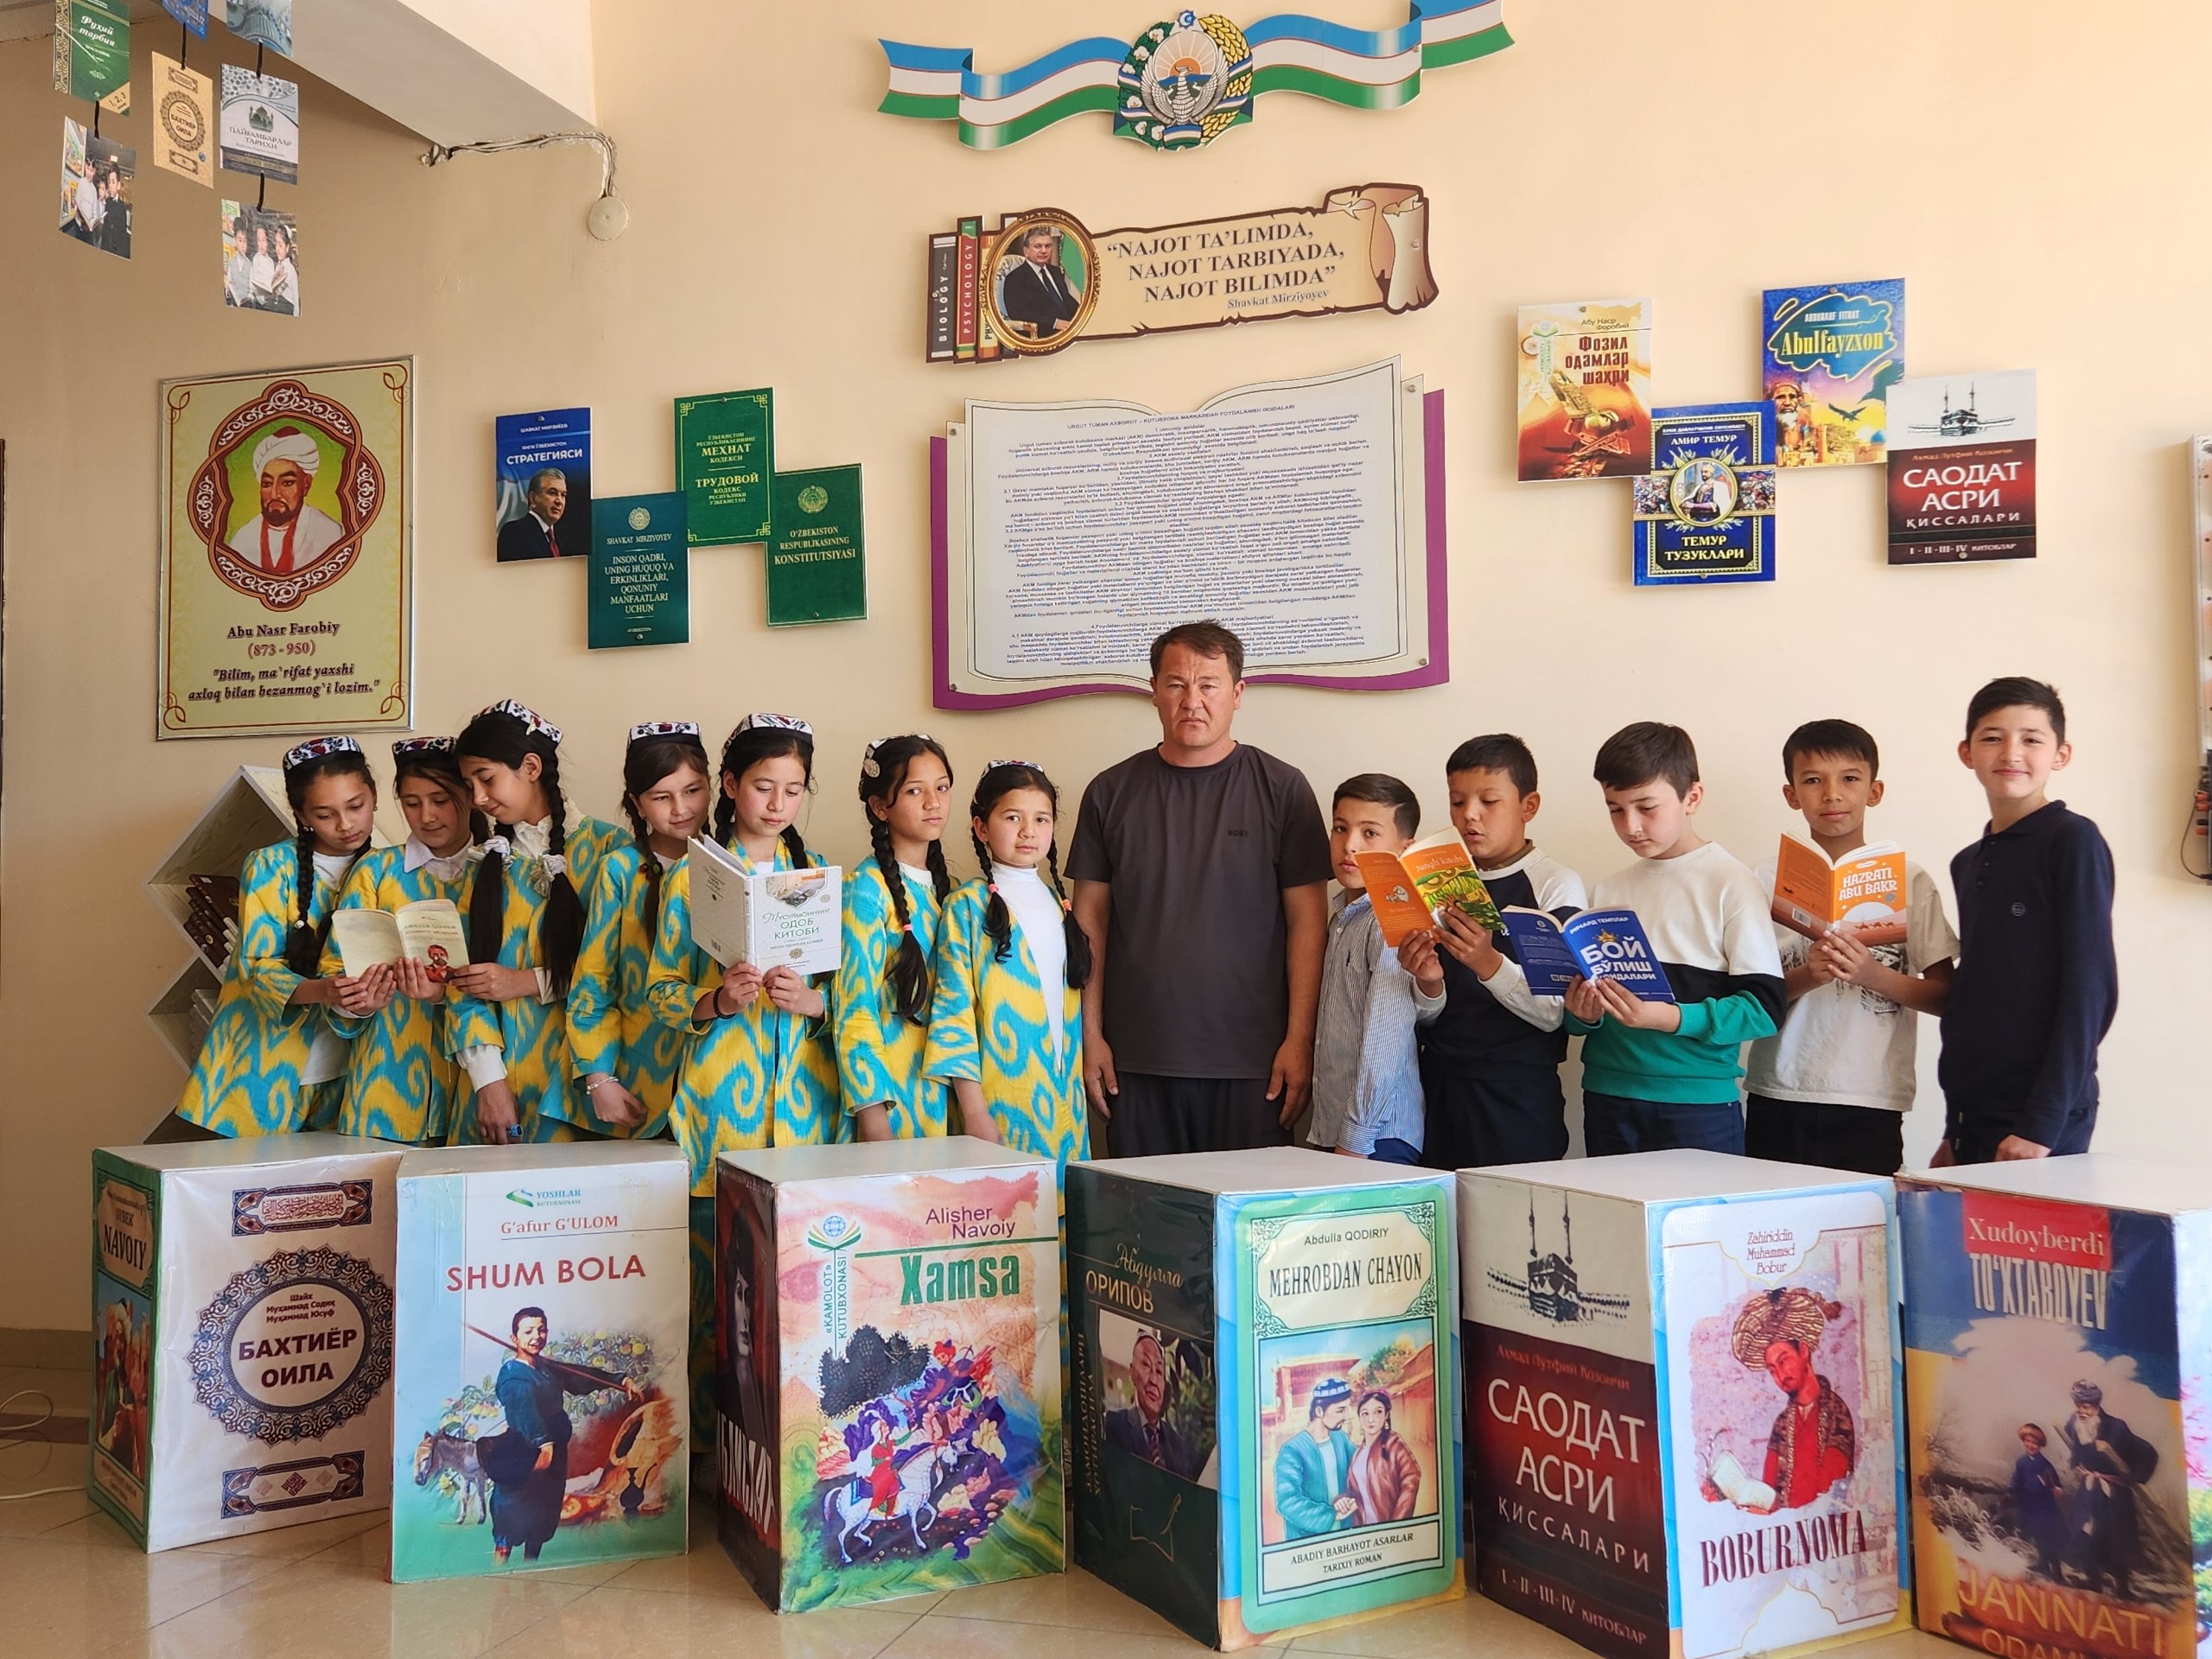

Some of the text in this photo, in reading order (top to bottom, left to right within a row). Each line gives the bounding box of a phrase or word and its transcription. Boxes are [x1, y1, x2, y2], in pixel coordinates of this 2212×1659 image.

[79, 28, 115, 47] тарбия
[1107, 222, 1313, 258] “NAJOT TA’LIMDA,
[1128, 242, 1344, 281] NAJOT TARBIYADA,
[963, 245, 973, 334] PSYCHOLOGY
[1143, 265, 1335, 302] NAJOT BILIMDA”
[939, 276, 948, 341] BIOLOGY
[1228, 290, 1329, 309] Shavkat Mirziyoyev
[1580, 336, 1628, 351] Фозил
[1781, 329, 1883, 359] Abulfayzxon
[1566, 353, 1628, 370] одамлар
[1583, 370, 1629, 386] шаҳри
[1702, 435, 1737, 443] ТЕМУР
[506, 448, 582, 465] СТРАТЕГИЯСИ
[695, 472, 759, 487] ТРУДОВОЙ
[1903, 461, 2024, 487] САОДАТ
[1921, 488, 2000, 512] АСРИ
[1906, 512, 2020, 529] ҚИССАЛАРИ
[636, 534, 671, 543] MIRZIYOYEV
[790, 526, 838, 537] O‘ZBEKISTON
[780, 537, 849, 550] RESPUBLIKASINING
[1681, 536, 1726, 546] ТЕМУР
[613, 553, 666, 564] INSON QADRI,
[774, 549, 855, 564] KONSTITUTSIYASI
[1664, 549, 1744, 561] ТУЗУКЛАРИ
[605, 566, 631, 575] UNING
[632, 563, 661, 573] HUQUQ
[610, 574, 669, 584] ERKINLIKLARI,
[621, 584, 658, 594] QONUNIY
[610, 593, 668, 604] MANFAATLARI
[625, 604, 654, 613] UCHUN
[227, 621, 340, 639] Abu Nasr Farobiy
[314, 663, 354, 680] yaxshi
[188, 689, 221, 702] axloq
[225, 687, 255, 698] bilan
[1843, 868, 1892, 887] HAZRATI
[1840, 880, 1897, 901] ABU BAKR
[781, 918, 813, 929] ОДОБ
[1570, 920, 1597, 934] РИЧАРД
[774, 926, 819, 940] КИТОБИ
[1580, 937, 1646, 964] БОЙ
[1590, 960, 1652, 975] БЎЛИШ
[537, 1190, 581, 1198] YOSHLAR
[925, 1206, 993, 1224] Alisher
[501, 1216, 618, 1234] G‘afur G‘ULOM
[952, 1219, 1015, 1239] Navoiy
[1304, 1228, 1389, 1245] Abdulla QODIRIY
[1747, 1229, 1793, 1244] Zahiriddin
[1968, 1217, 2105, 1255] Xudoyberdi
[104, 1224, 146, 1270] NAVOIY
[1747, 1243, 1796, 1260] Muhammad
[447, 1255, 646, 1292] SHUM BOLA
[1115, 1243, 1183, 1287] Абдулла
[1757, 1261, 1787, 1274] Bobur
[900, 1255, 1020, 1306] Xamsa
[1269, 1253, 1422, 1298] MEHROBDAN CHAYON
[290, 1293, 313, 1301] Шайх
[823, 1264, 833, 1333] «KAMOLOT»
[838, 1256, 848, 1338] KUTUBXONASI
[1086, 1270, 1154, 1313] ОРИПОВ
[1968, 1253, 2107, 1330] TO‘XTABOYEV
[311, 1309, 334, 1318] Юсуф
[238, 1327, 358, 1360] БАХТИЁР
[261, 1363, 334, 1388] ОИЛА
[1488, 1378, 1645, 1463] САОДАТ
[1516, 1446, 1616, 1522] АСРИ
[1498, 1497, 1649, 1573] ҚИССАЛАРИ
[1291, 1533, 1414, 1565] ABADIY BARHAYOT ASARLAR
[1700, 1510, 1866, 1587] BOBURNOMA
[1323, 1553, 1382, 1573] TARIXIY ROMAN
[1959, 1569, 2162, 1656] JANNATI
[1582, 1608, 1647, 1644] КИТОБЛАР
